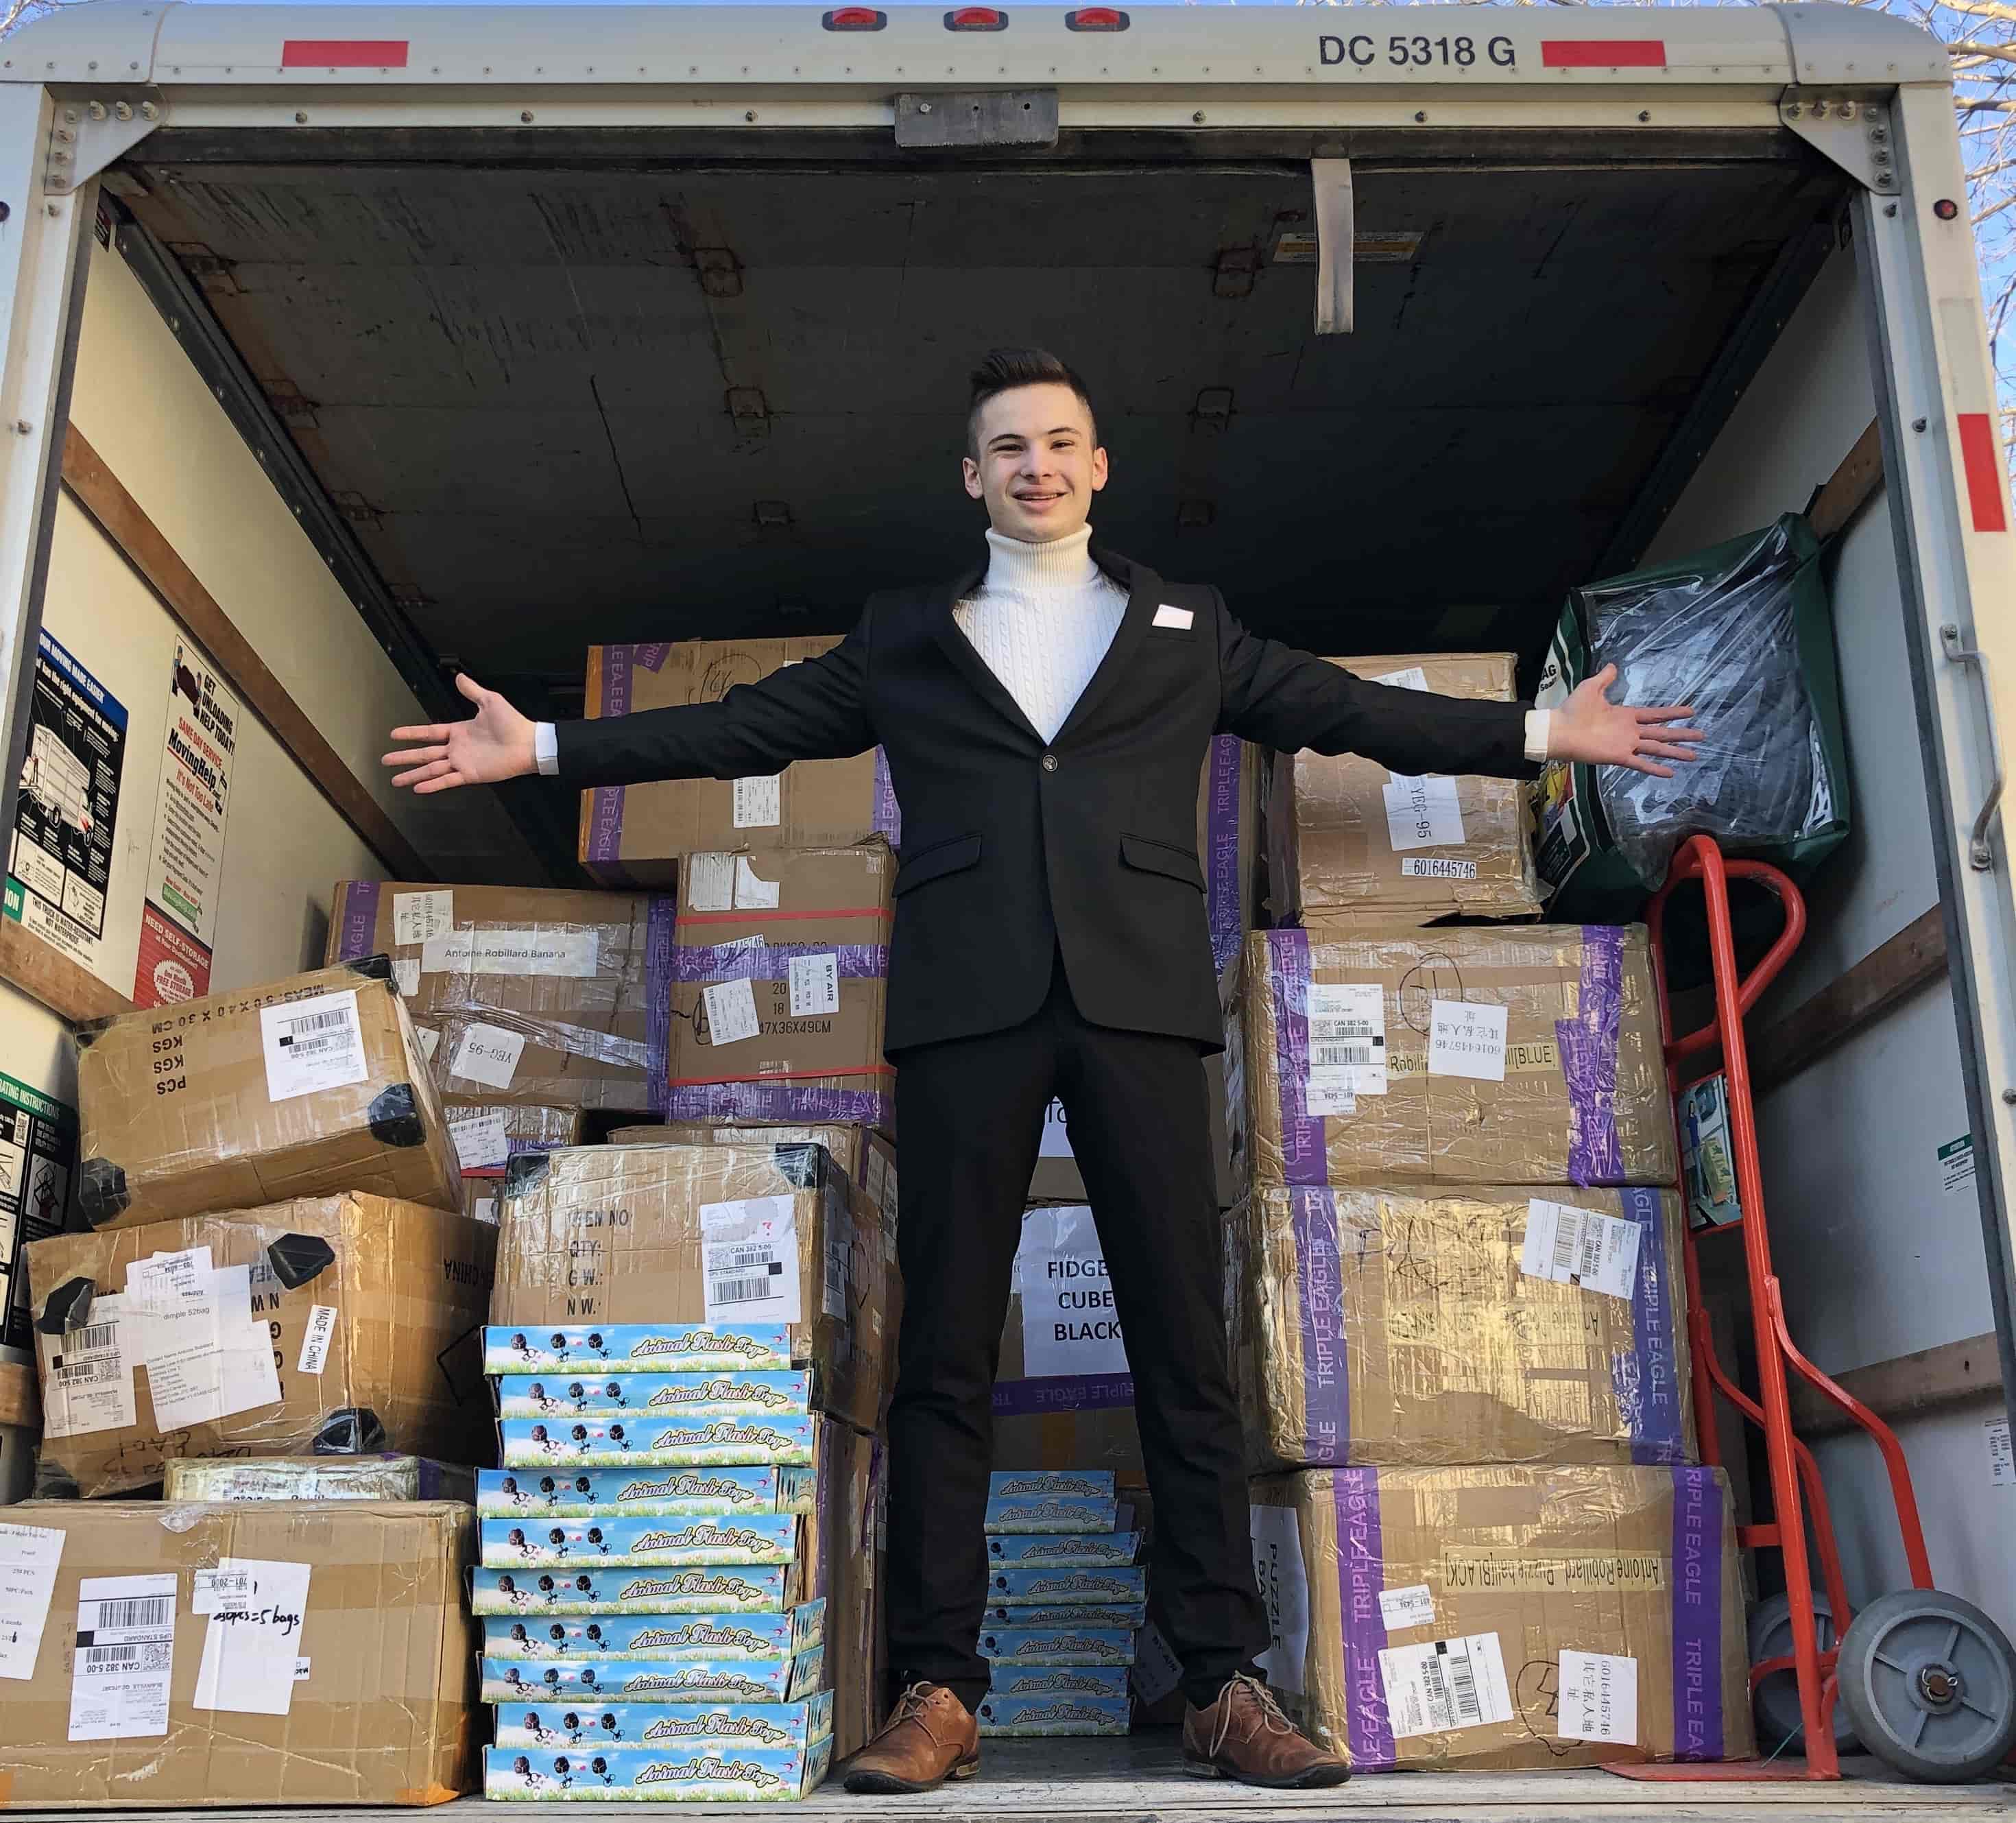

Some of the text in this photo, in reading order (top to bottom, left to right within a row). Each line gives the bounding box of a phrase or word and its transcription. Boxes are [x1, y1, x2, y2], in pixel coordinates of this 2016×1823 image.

[1319, 36, 1516, 67] DC 5318 G
[51, 644, 71, 673] MOVING
[204, 674, 216, 695] GET
[202, 691, 233, 735] UNLOADING
[178, 717, 193, 741] SAME
[200, 709, 235, 756] HELP TODAY!
[1216, 770, 1230, 815] TRIPLE
[1410, 785, 1432, 839] YEG-95
[1216, 833, 1229, 879] EAGLE
[1413, 859, 1476, 879] 6016445746
[145, 914, 164, 933] NEED
[485, 947, 528, 959] Robillard
[530, 949, 566, 959] Banana
[773, 982, 787, 995] 20
[825, 964, 834, 1002] BY AIR
[773, 1003, 784, 1015] 18
[152, 1020, 173, 1034] CM
[152, 1035, 183, 1053] KGS
[467, 1040, 513, 1064] YEG-95
[154, 1054, 184, 1074] KGS
[157, 1075, 187, 1095] PCS
[21, 1088, 60, 1119] INSTRUCTIONS
[730, 1246, 745, 1254] CAN
[1594, 1239, 1602, 1253] CAN
[1057, 1290, 1114, 1310] CUBE
[1640, 1261, 1659, 1332] TRIPLE
[163, 1309, 187, 1320] dimple
[305, 1308, 330, 1370] MADE IN CHINA
[1053, 1321, 1122, 1342] BLACK
[632, 1332, 769, 1359] Animal Flash Toys
[1313, 1315, 1336, 1389] TRIPLE
[85, 1375, 99, 1383] CAN
[1647, 1336, 1668, 1406] EAGLE
[649, 1380, 787, 1407] Animal Flash Toys
[653, 1423, 792, 1451] Animal Flash Toys
[619, 1475, 754, 1503] Animal Flash Toys
[1686, 1468, 1702, 1529] RIPLE
[632, 1525, 773, 1553] Animal Flash Toys
[1518, 1560, 1555, 1586] Puzzle
[1565, 1559, 1614, 1586] Robillard
[1617, 1559, 1659, 1585] Antoine
[1685, 1534, 1702, 1606] EAGLE
[621, 1573, 762, 1600] Animal Flash Toys
[1269, 1542, 1281, 1651] PUZZLE
[1345, 1469, 1380, 1733] EAGLE TRIPLE EAGLE
[273, 1604, 300, 1636] bags
[124, 1633, 172, 1643] UPS STANDARD
[630, 1624, 769, 1652] Animal Flash Toys
[86, 1662, 141, 1673] CAN 382 5-00
[1686, 1638, 1704, 1716] TRIPLE
[625, 1669, 765, 1695] Animal Flash Toys
[1423, 1676, 1431, 1687] 382
[1424, 1688, 1434, 1702] CAN
[1567, 1687, 1580, 1702] 址
[1582, 1660, 1596, 1733] 其它私人地
[645, 1714, 786, 1743] Animal Flash Toys
[636, 1757, 780, 1788] Animal Flash Toys
